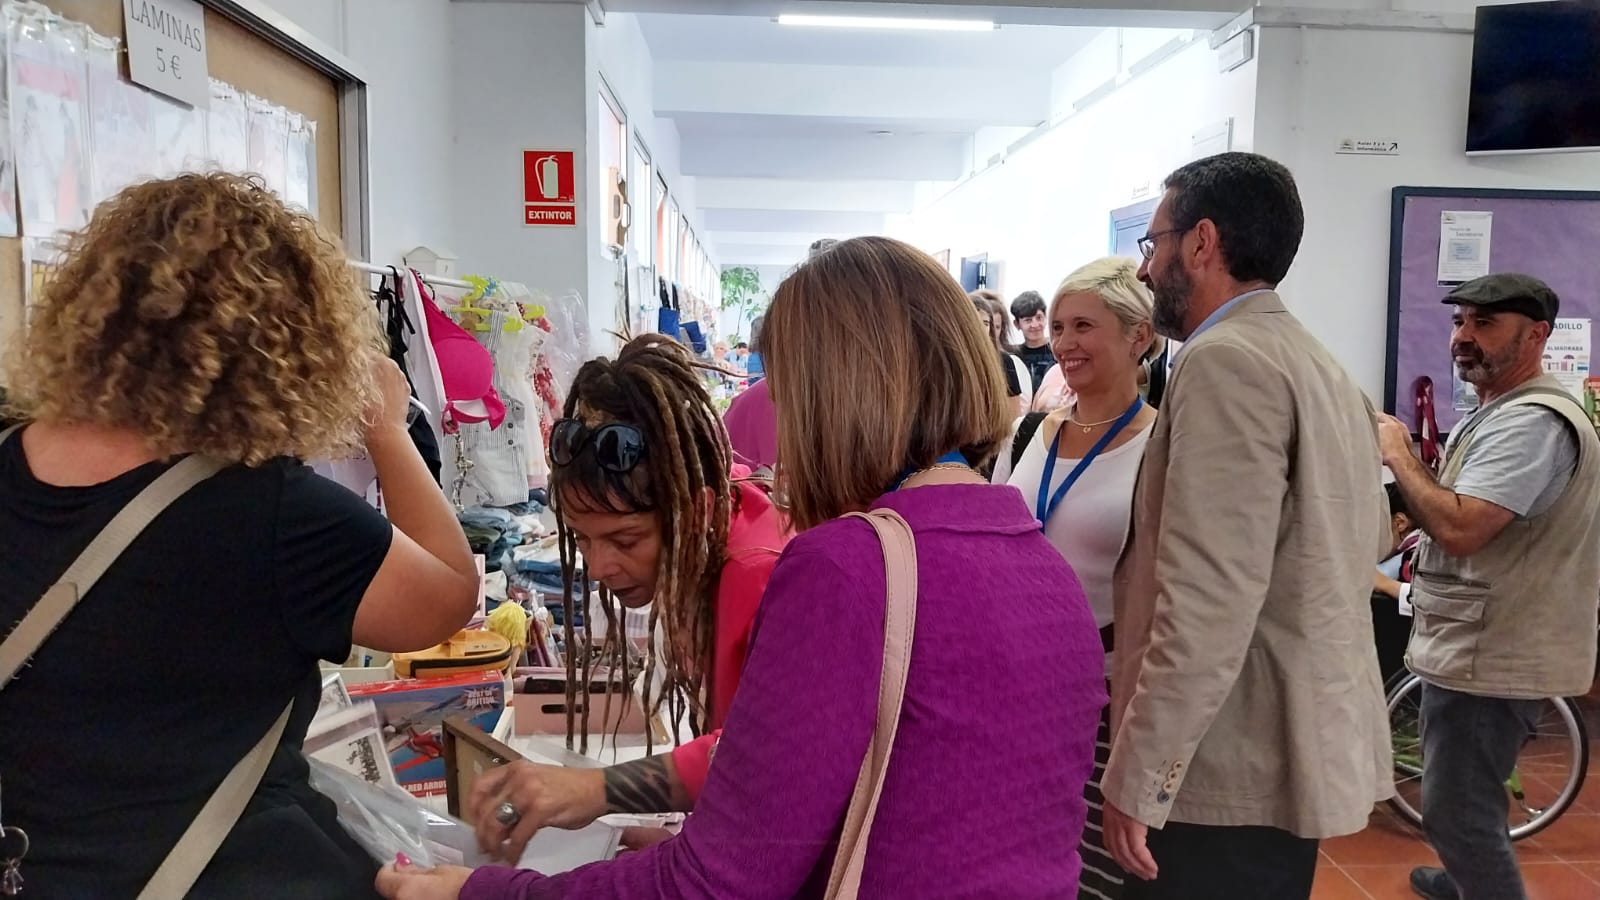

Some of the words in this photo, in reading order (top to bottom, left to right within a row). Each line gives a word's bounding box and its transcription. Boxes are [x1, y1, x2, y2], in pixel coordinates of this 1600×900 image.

[131, 0, 202, 52] LAMINAS
[156, 47, 166, 72] 5
[171, 55, 182, 79] €
[528, 210, 573, 220] EXTINTOR
